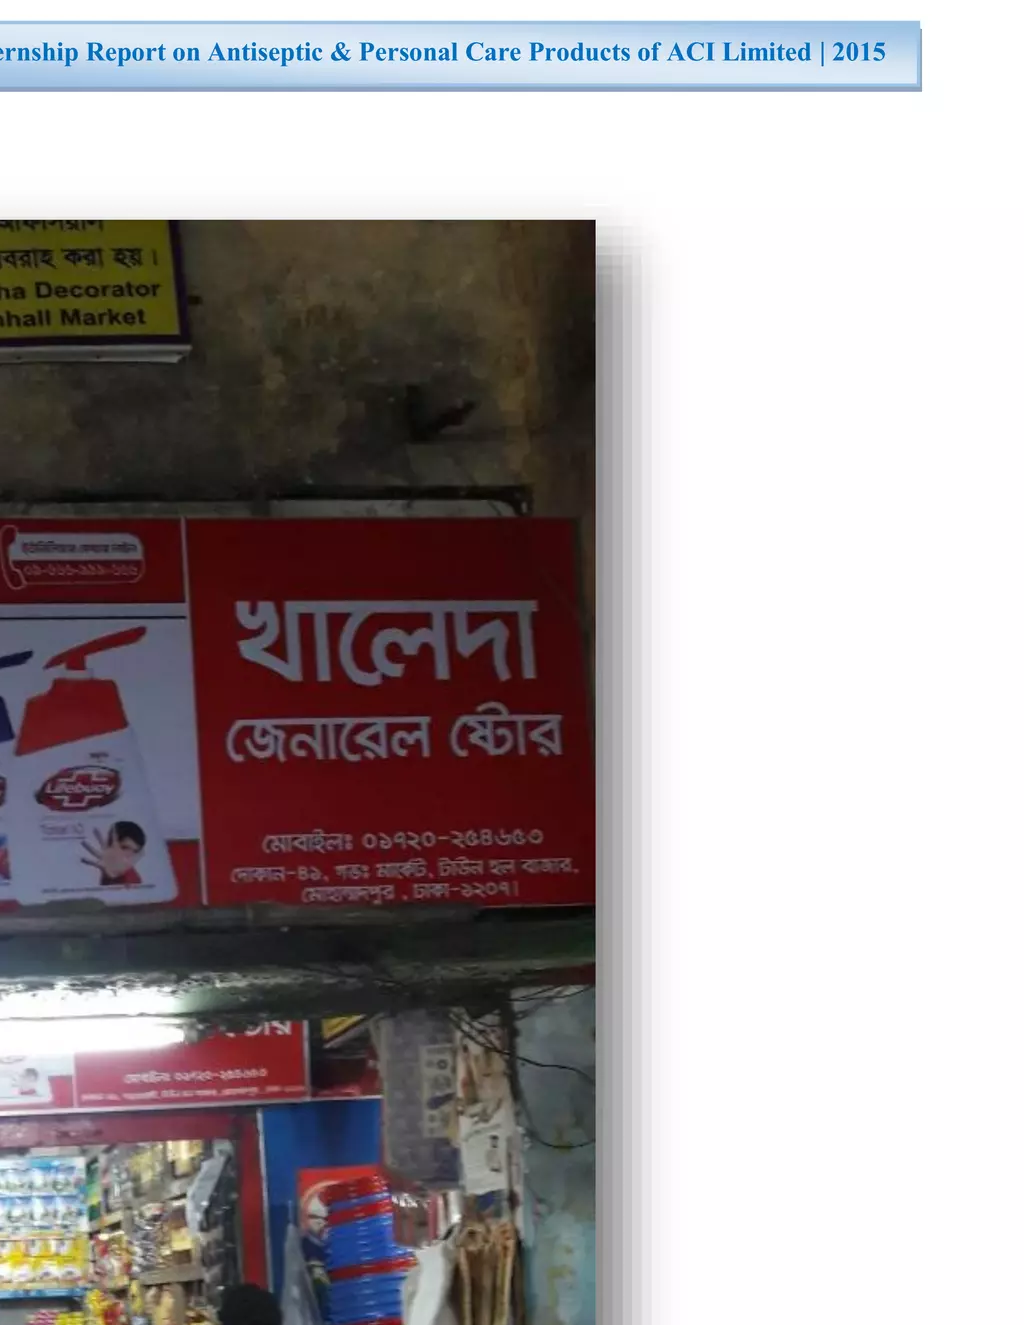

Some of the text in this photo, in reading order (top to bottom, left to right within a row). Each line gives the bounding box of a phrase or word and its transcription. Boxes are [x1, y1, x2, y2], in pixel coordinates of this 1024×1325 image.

[62, 246, 105, 268] করা
[36, 280, 162, 300] Decorator
[60, 308, 146, 327] Market
[234, 600, 539, 686] খালেদা
[225, 701, 564, 763] জেনারেল ষ্টোর
